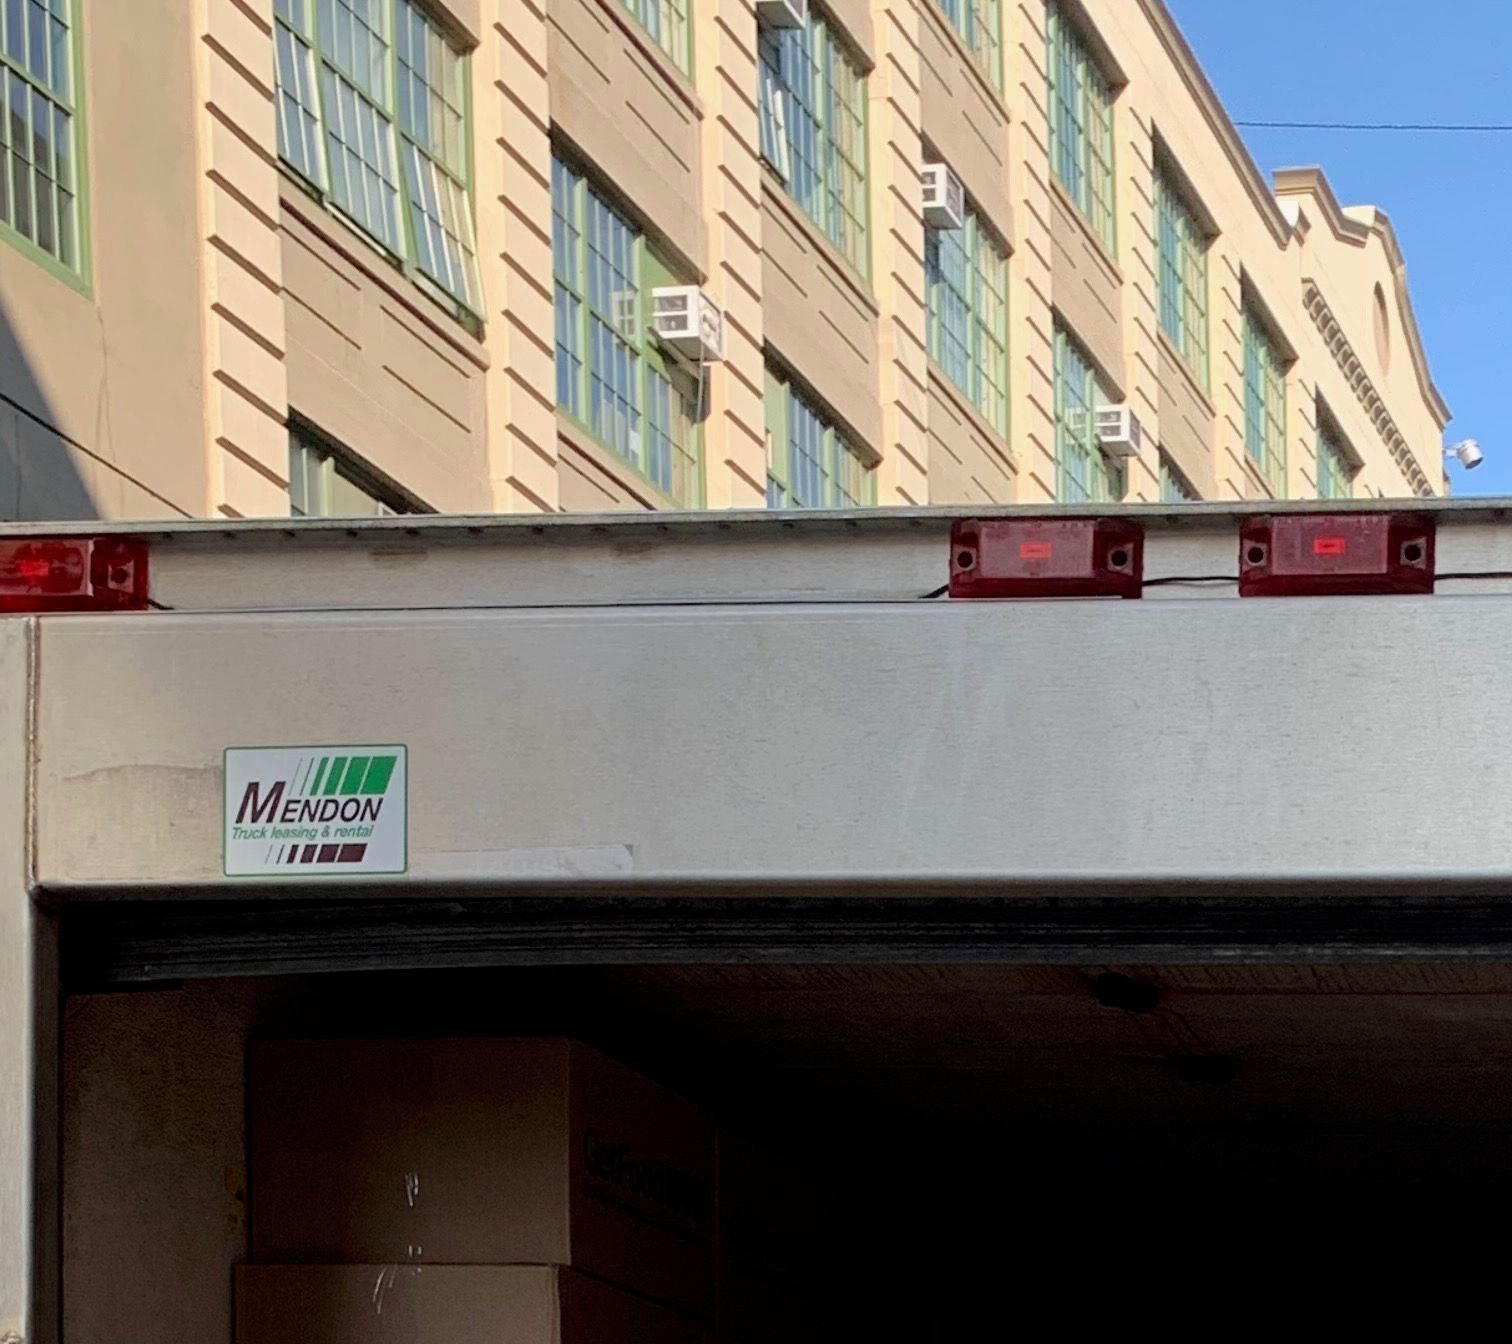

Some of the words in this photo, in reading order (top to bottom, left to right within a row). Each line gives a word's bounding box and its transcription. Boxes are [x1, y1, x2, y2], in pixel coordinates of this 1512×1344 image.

[235, 781, 383, 824] MENDON
[232, 826, 268, 840] Truck
[271, 825, 318, 841] leasing
[321, 825, 330, 838] &
[334, 824, 374, 838] rental
